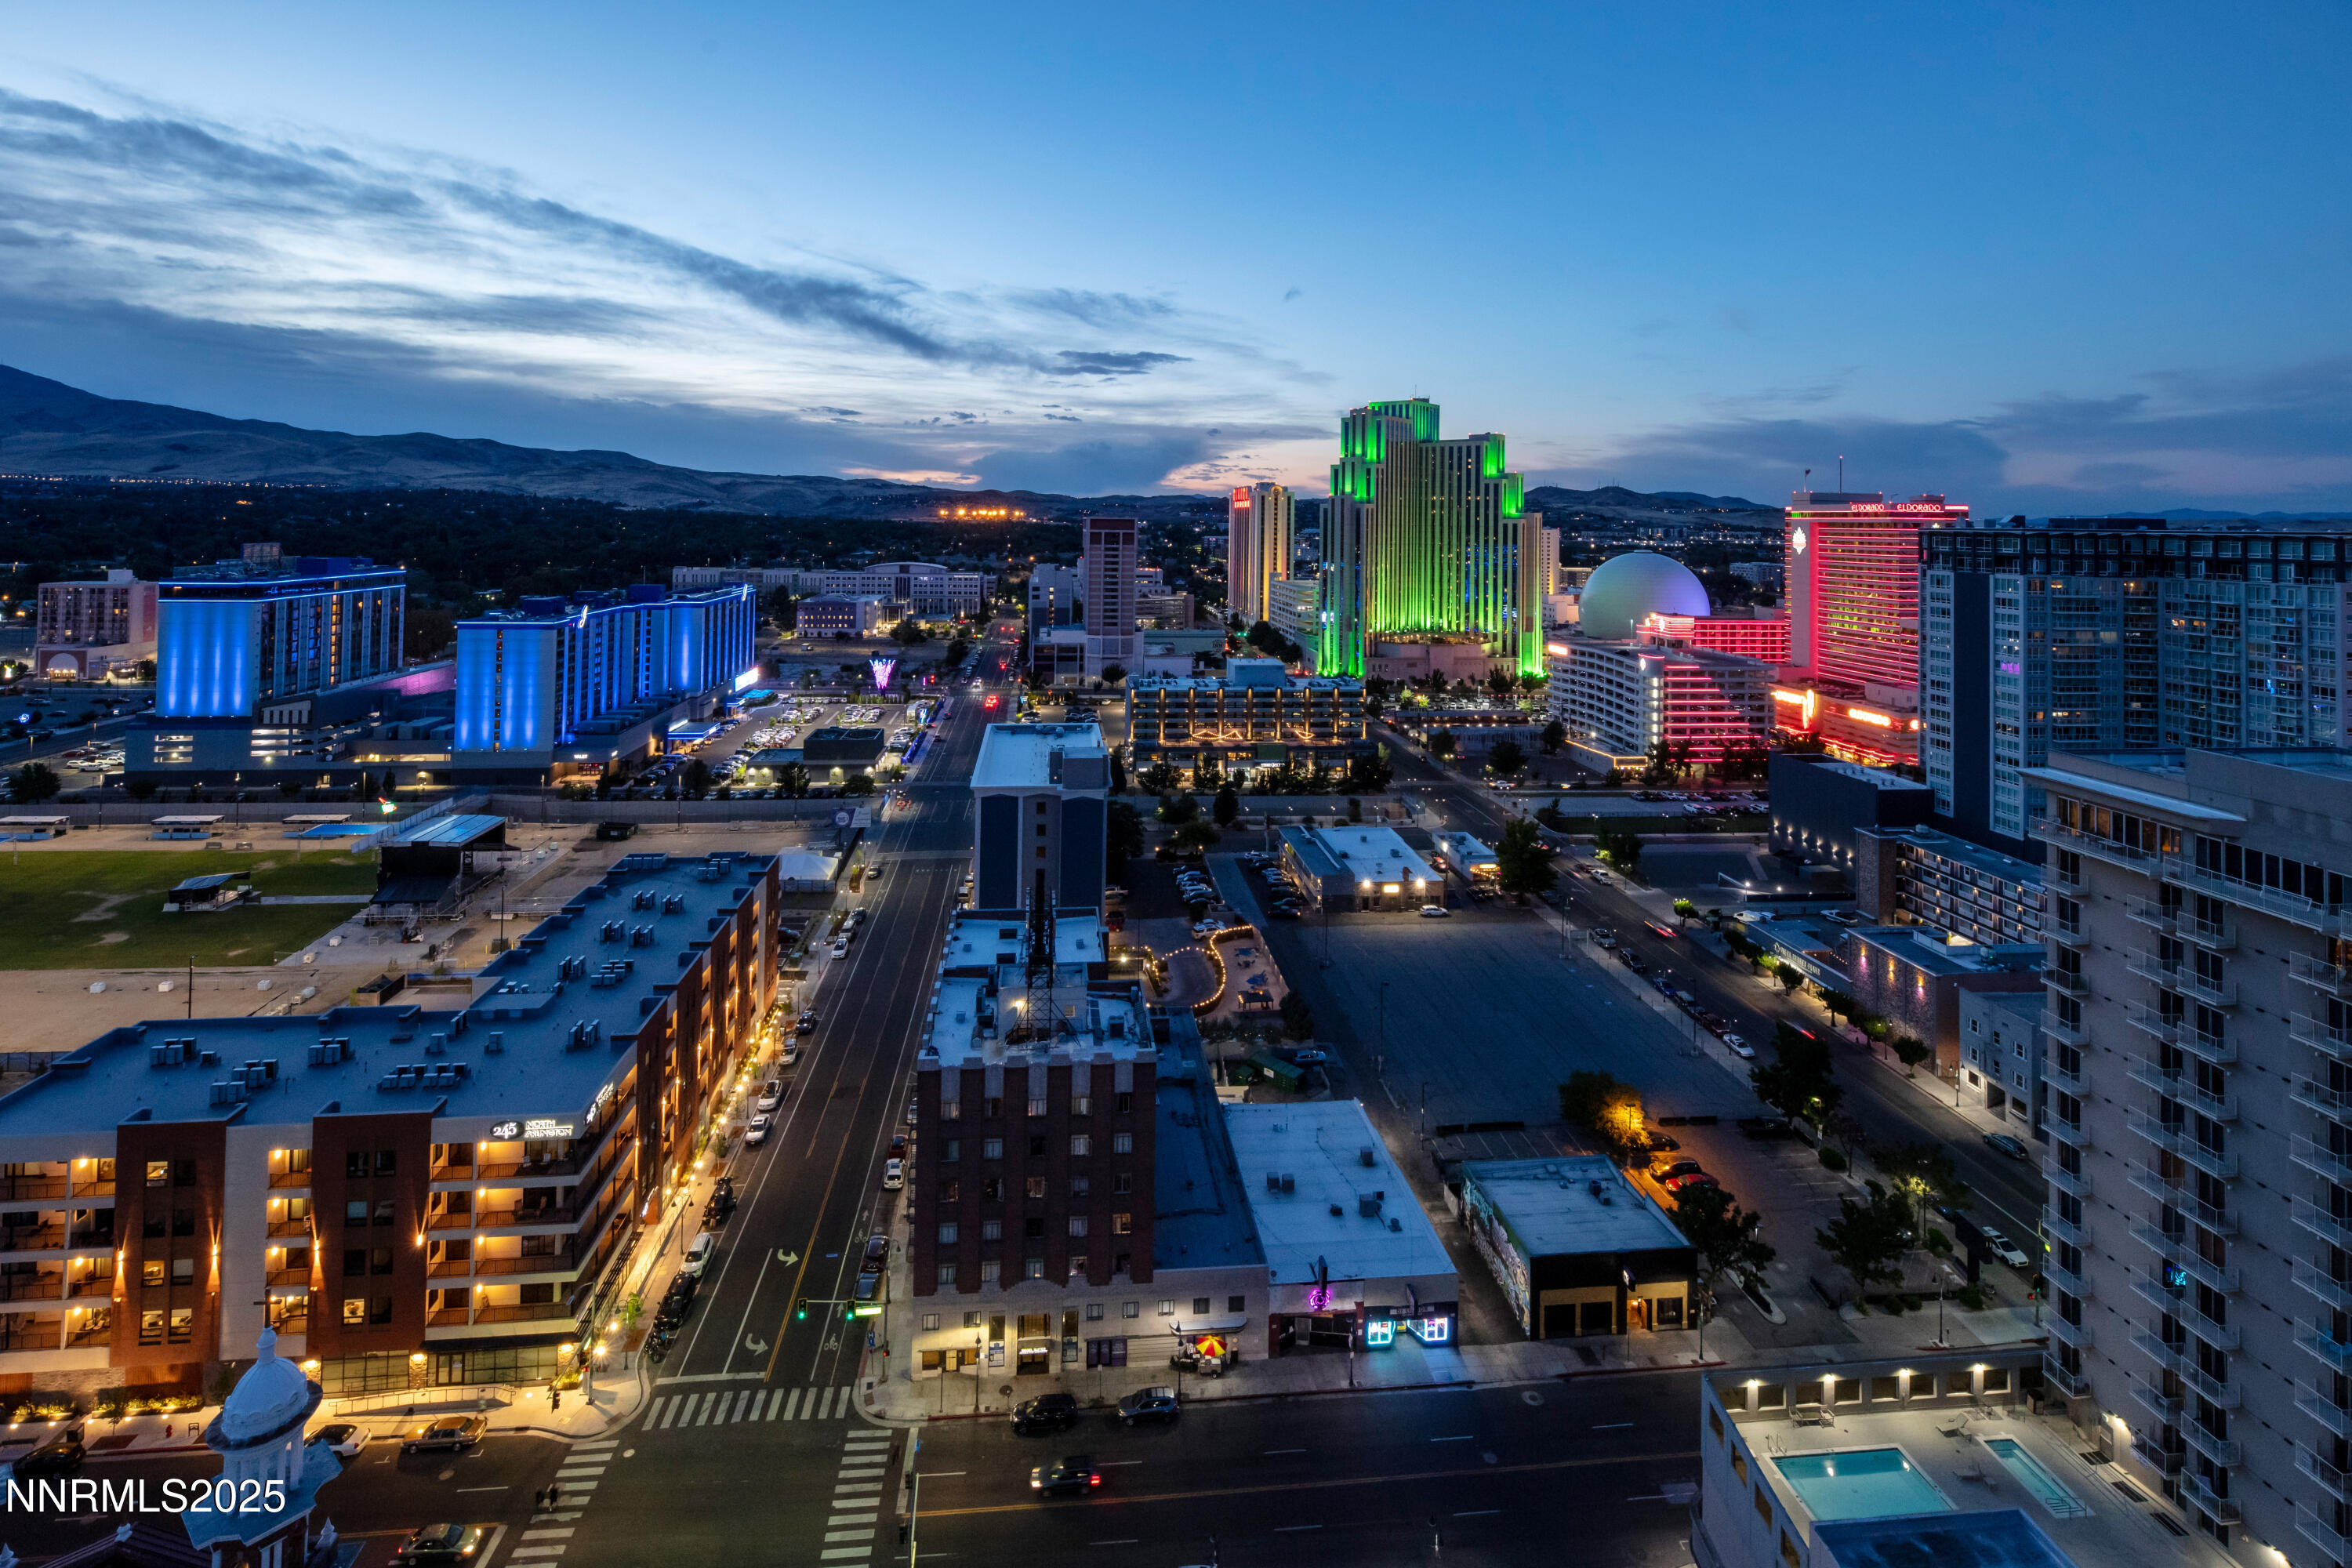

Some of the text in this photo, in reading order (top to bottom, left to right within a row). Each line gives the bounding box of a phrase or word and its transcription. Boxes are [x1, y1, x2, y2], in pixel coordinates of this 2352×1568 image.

[1896, 503, 1941, 512] ELDORADO
[493, 1123, 517, 1139] 245
[524, 1129, 572, 1138] ARLINGTON
